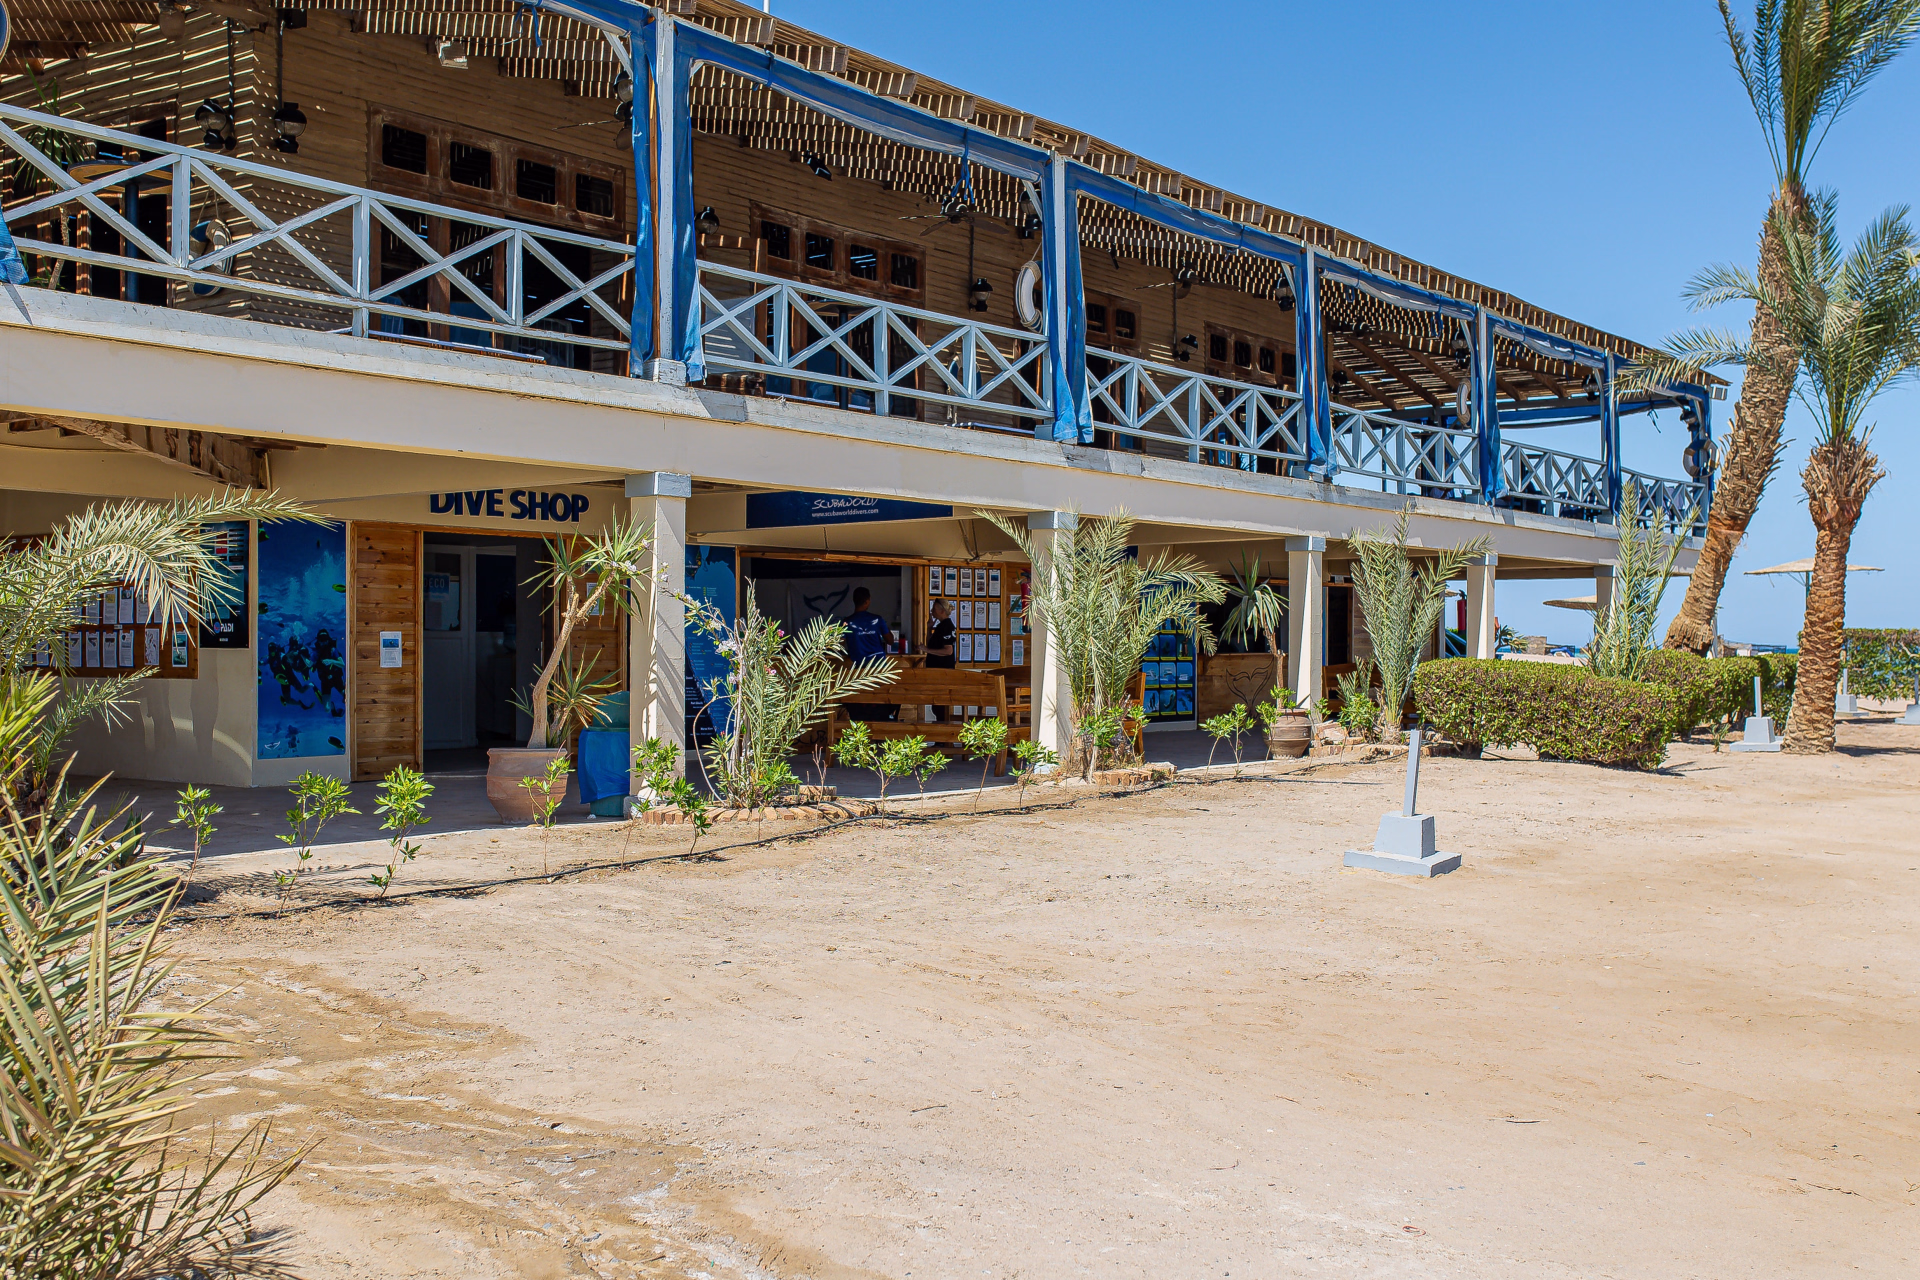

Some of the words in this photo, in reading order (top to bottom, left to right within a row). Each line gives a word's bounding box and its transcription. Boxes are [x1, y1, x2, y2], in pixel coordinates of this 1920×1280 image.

[430, 489, 504, 518] DIVE
[510, 490, 590, 523] SHOP
[811, 508, 879, 518] www.scubaworlddivers.com
[220, 623, 234, 632] PADI
